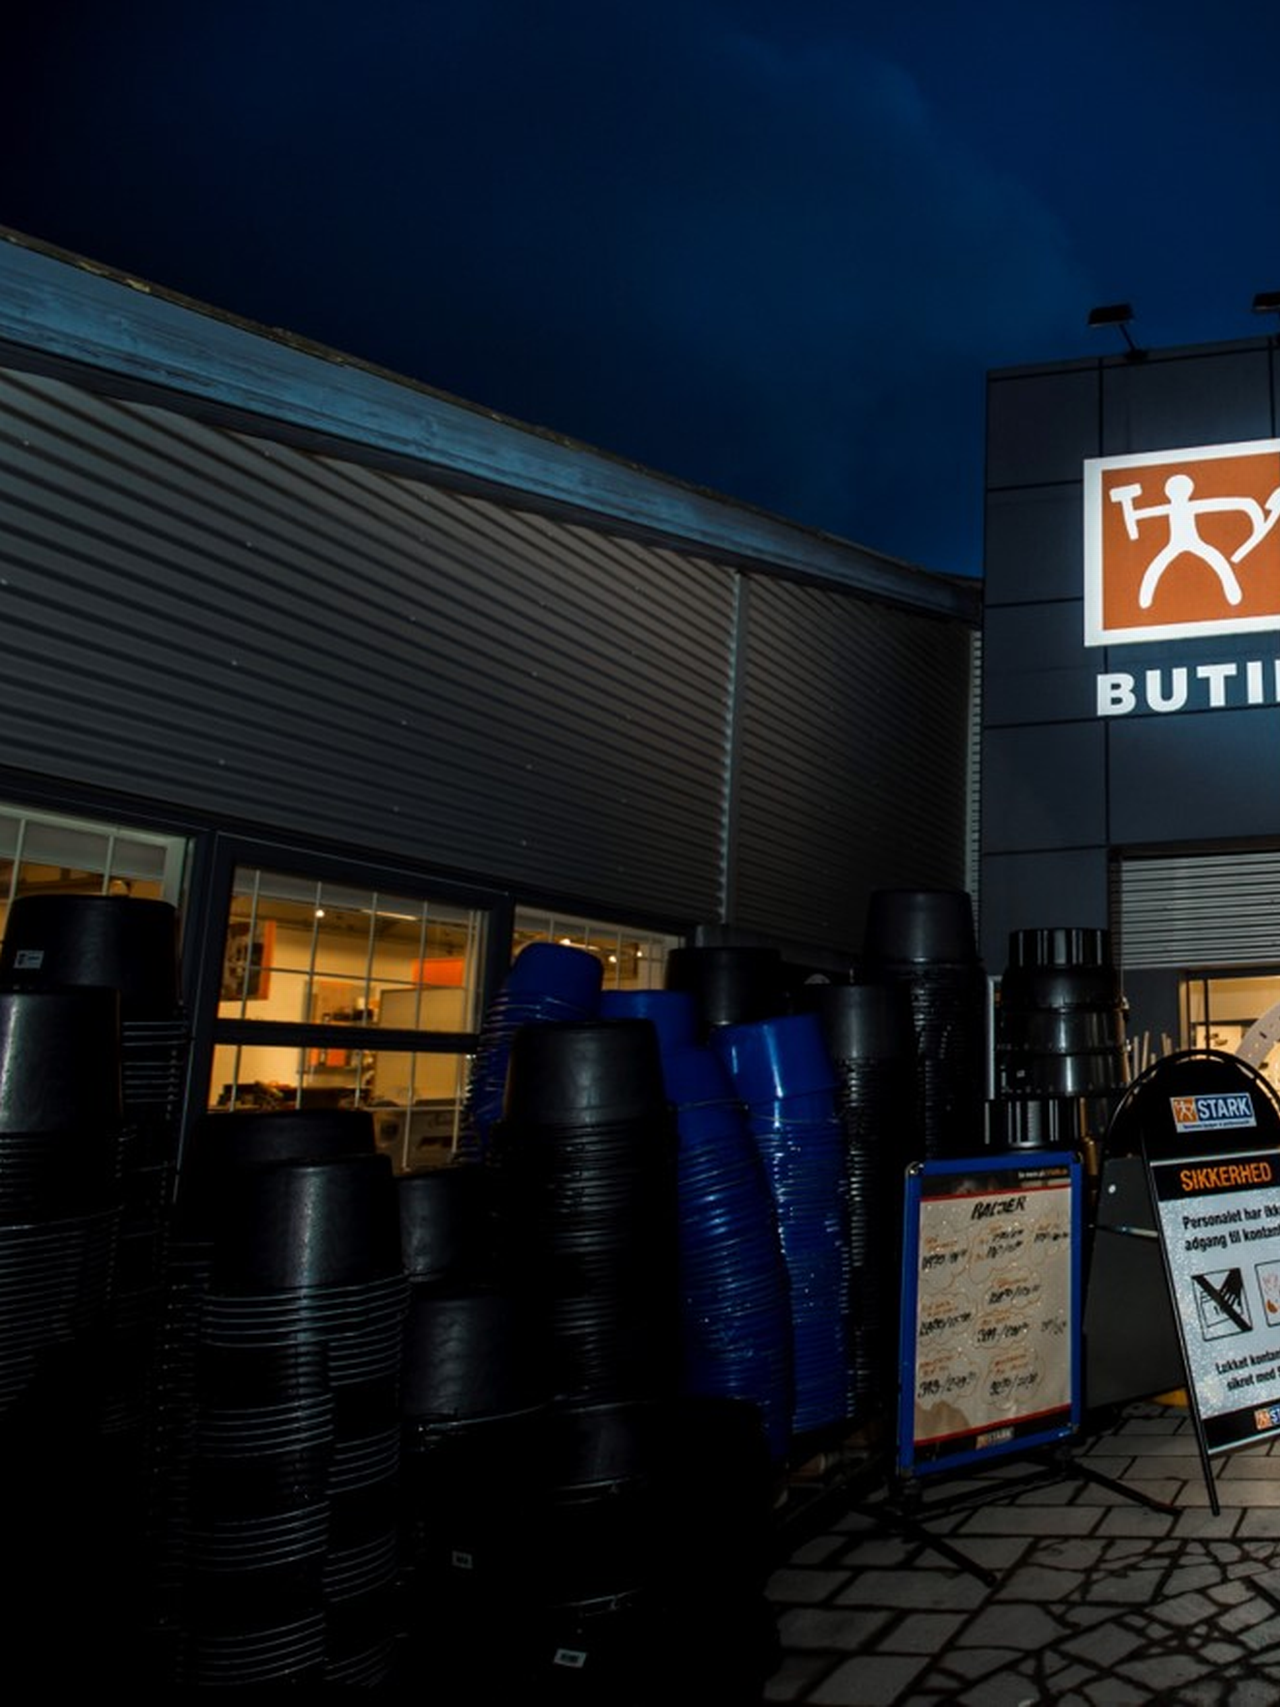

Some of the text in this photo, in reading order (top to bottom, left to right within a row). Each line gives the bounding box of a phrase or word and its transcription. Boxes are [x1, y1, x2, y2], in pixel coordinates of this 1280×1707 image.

[1197, 1097, 1251, 1119] STARK
[1180, 1162, 1272, 1192] SIKKERHED
[1182, 1211, 1243, 1230] Personalet
[1245, 1208, 1262, 1221] har
[1185, 1233, 1227, 1252] adgang
[1229, 1231, 1241, 1244] til
[1215, 1357, 1248, 1375] Lukket
[1227, 1374, 1254, 1391] sikret
[1256, 1368, 1276, 1383] med
